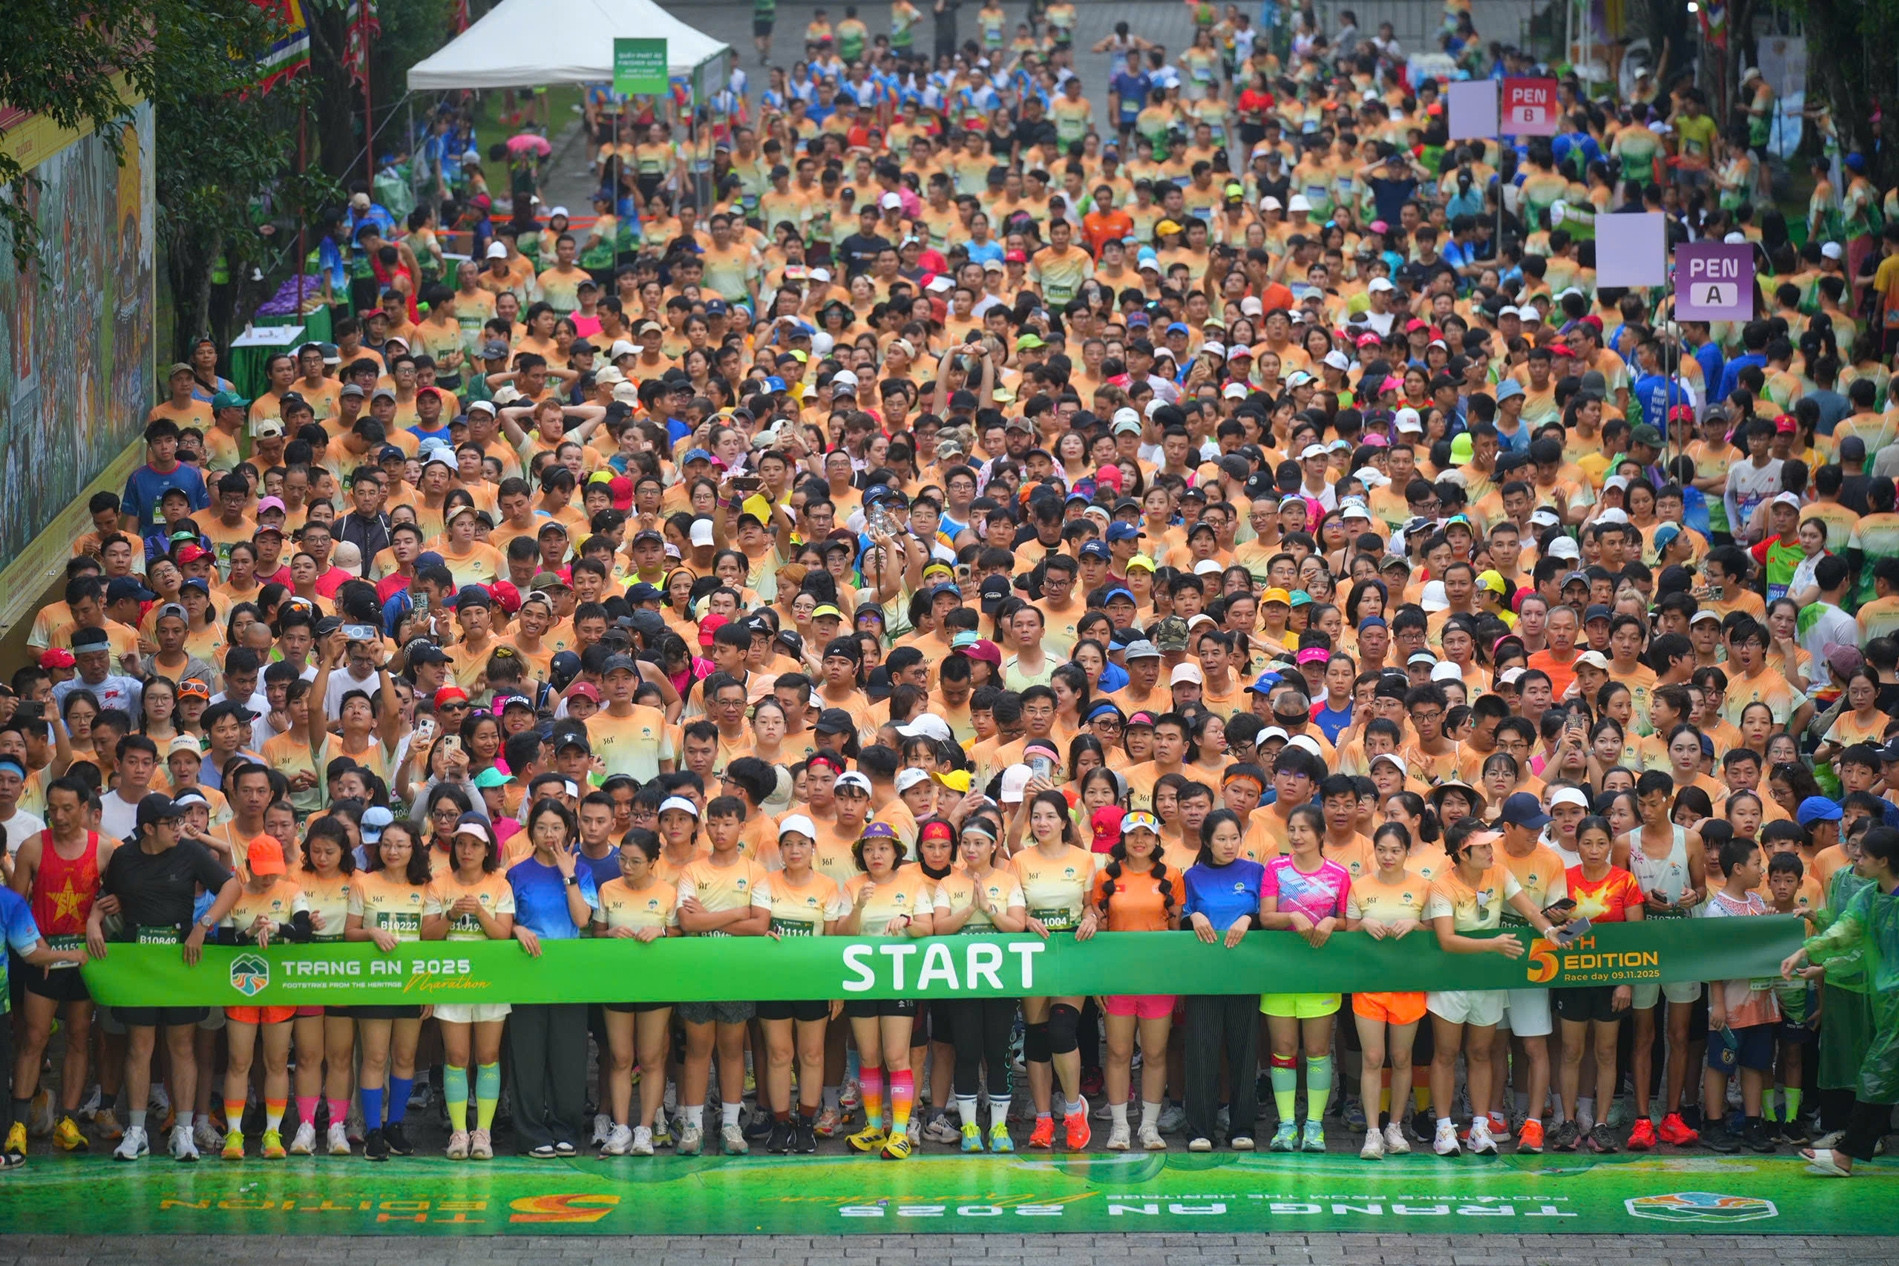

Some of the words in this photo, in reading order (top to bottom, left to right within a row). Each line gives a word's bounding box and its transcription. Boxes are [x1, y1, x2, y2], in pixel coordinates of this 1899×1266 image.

[1512, 87, 1547, 104] PEN
[1523, 108, 1534, 122] B
[1690, 258, 1739, 278] PEN
[1705, 285, 1723, 304] A
[380, 920, 418, 931] B10222
[140, 935, 177, 944] B10849
[281, 961, 361, 976] TRANG
[370, 960, 402, 975] AN
[411, 959, 471, 975] 2025
[842, 941, 1046, 992] START
[1527, 937, 1560, 983] 5
[1563, 951, 1660, 970] EDITION
[403, 971, 492, 993] Marathon
[1564, 973, 1589, 982] Race
[1591, 972, 1609, 981] day
[1611, 970, 1661, 980] 09.11.2025
[159, 1199, 489, 1211] EDITION
[508, 1193, 622, 1223] 5
[838, 1204, 1064, 1217] 2025
[1107, 1203, 1227, 1216] AN
[1269, 1203, 1578, 1217] TRANG
[376, 1213, 486, 1223] TH
